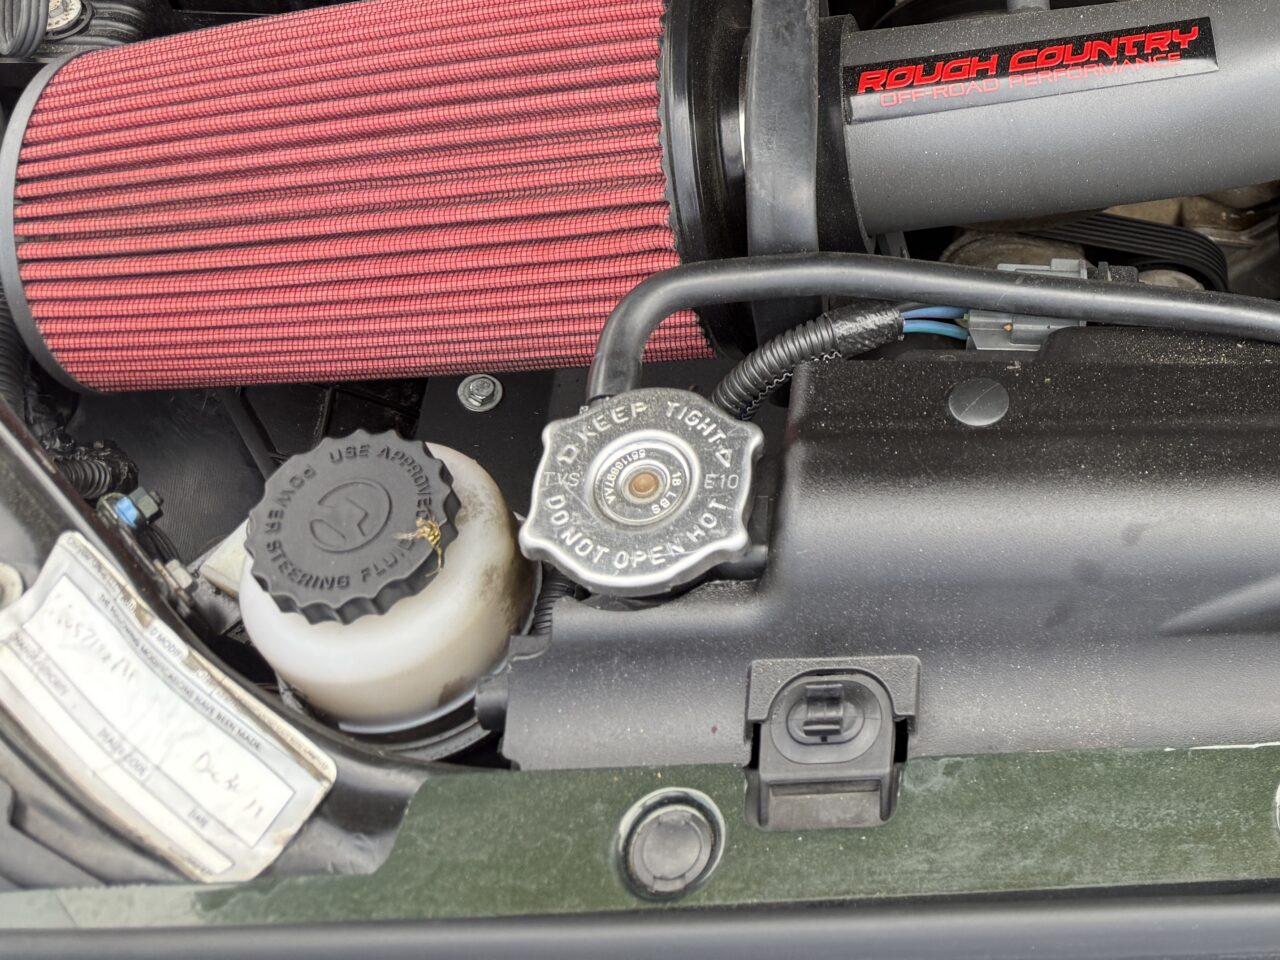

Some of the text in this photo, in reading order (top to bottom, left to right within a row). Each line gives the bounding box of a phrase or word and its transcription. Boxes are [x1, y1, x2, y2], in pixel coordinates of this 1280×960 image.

[857, 26, 1199, 94] ROUGH COUNTRY
[880, 51, 1183, 108] OFF-ROAD PERFORMANCE
[577, 400, 727, 444] KEEP TIGHT
[543, 470, 580, 487] TVS
[651, 471, 682, 515] 18 LBS
[704, 473, 740, 489] E10
[265, 464, 351, 591] POWER STEERING
[329, 444, 371, 464] USE
[360, 538, 416, 583] FLUID
[546, 495, 727, 570] DO NOT OPEN HOT
[193, 693, 217, 716] HAVE
[216, 712, 237, 732] BEEN
